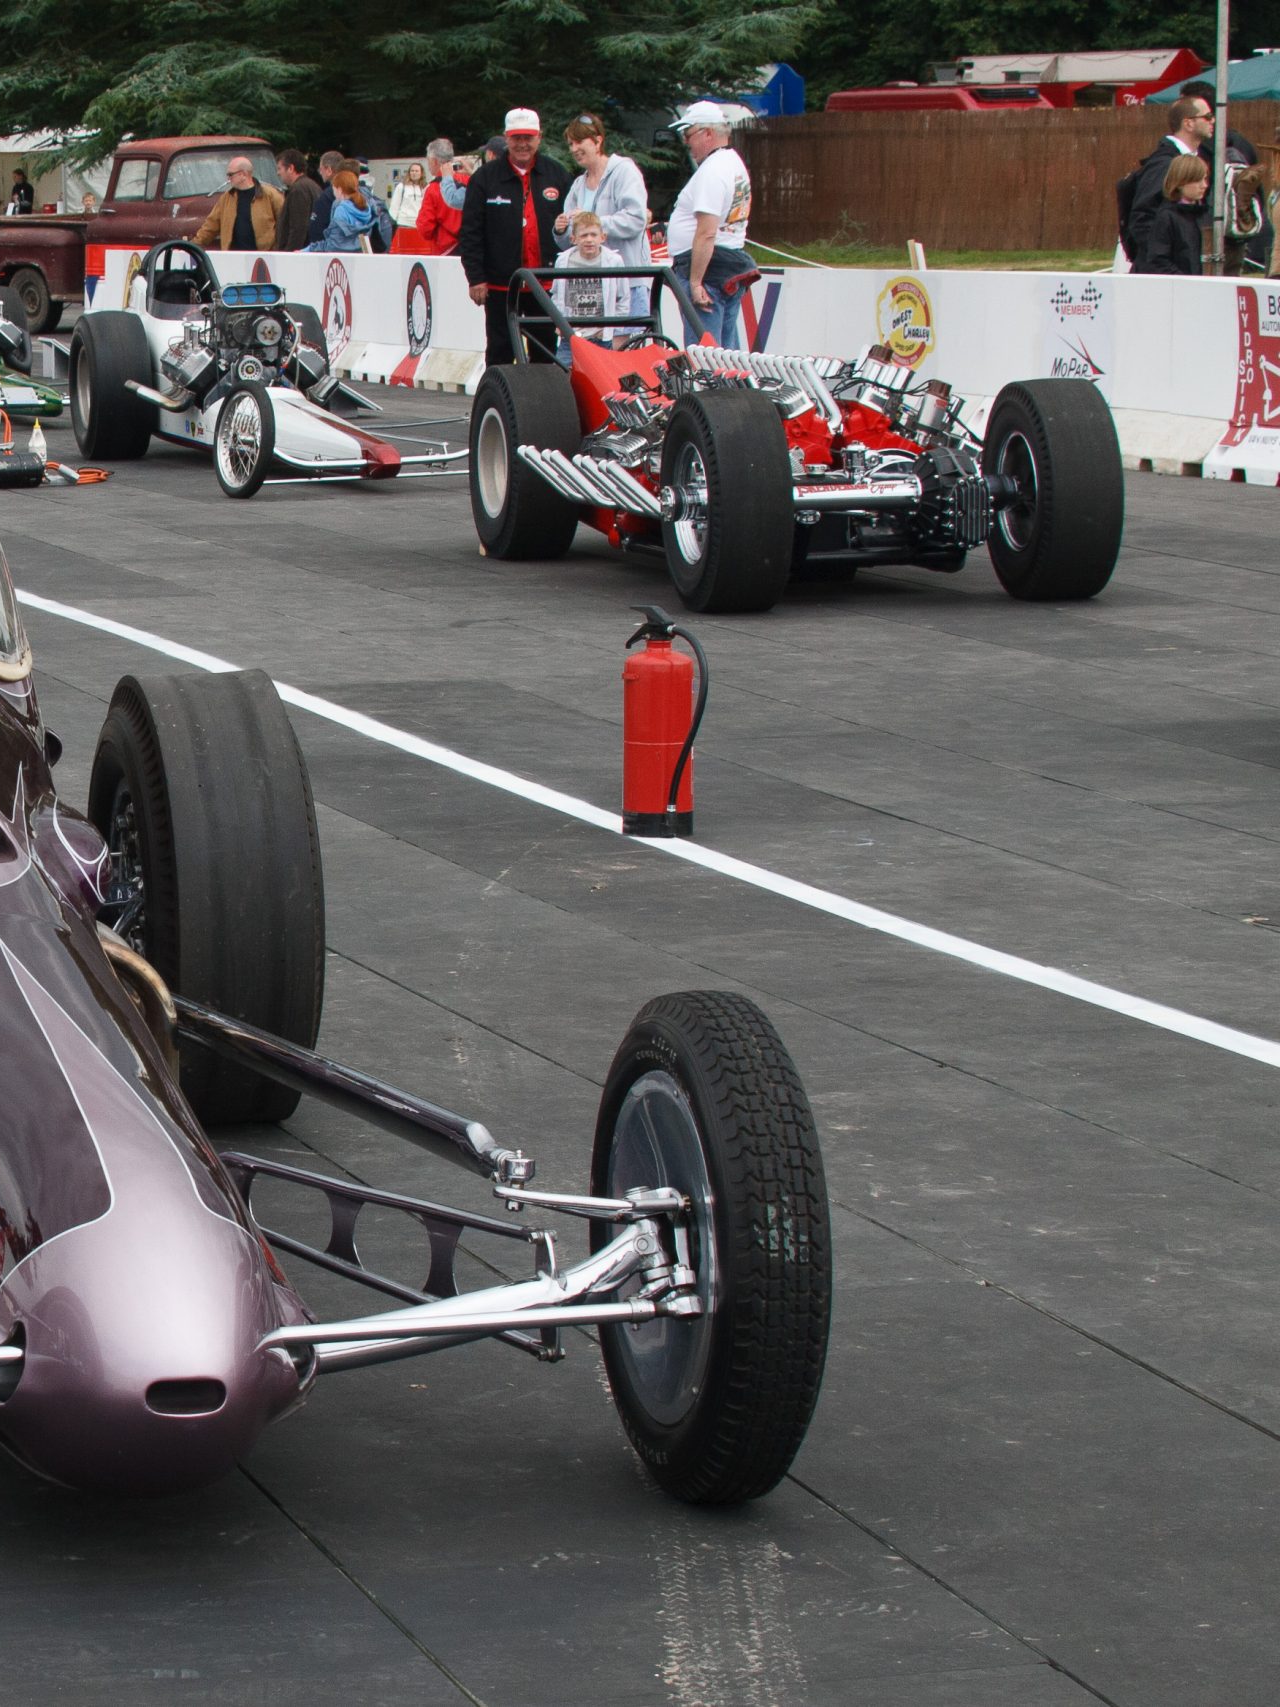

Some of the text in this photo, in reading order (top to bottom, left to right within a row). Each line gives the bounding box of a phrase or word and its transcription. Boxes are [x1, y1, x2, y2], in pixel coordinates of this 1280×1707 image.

[1060, 304, 1093, 316] MEMBER
[1238, 295, 1254, 384] HYDRO
[1233, 359, 1248, 443] STICK
